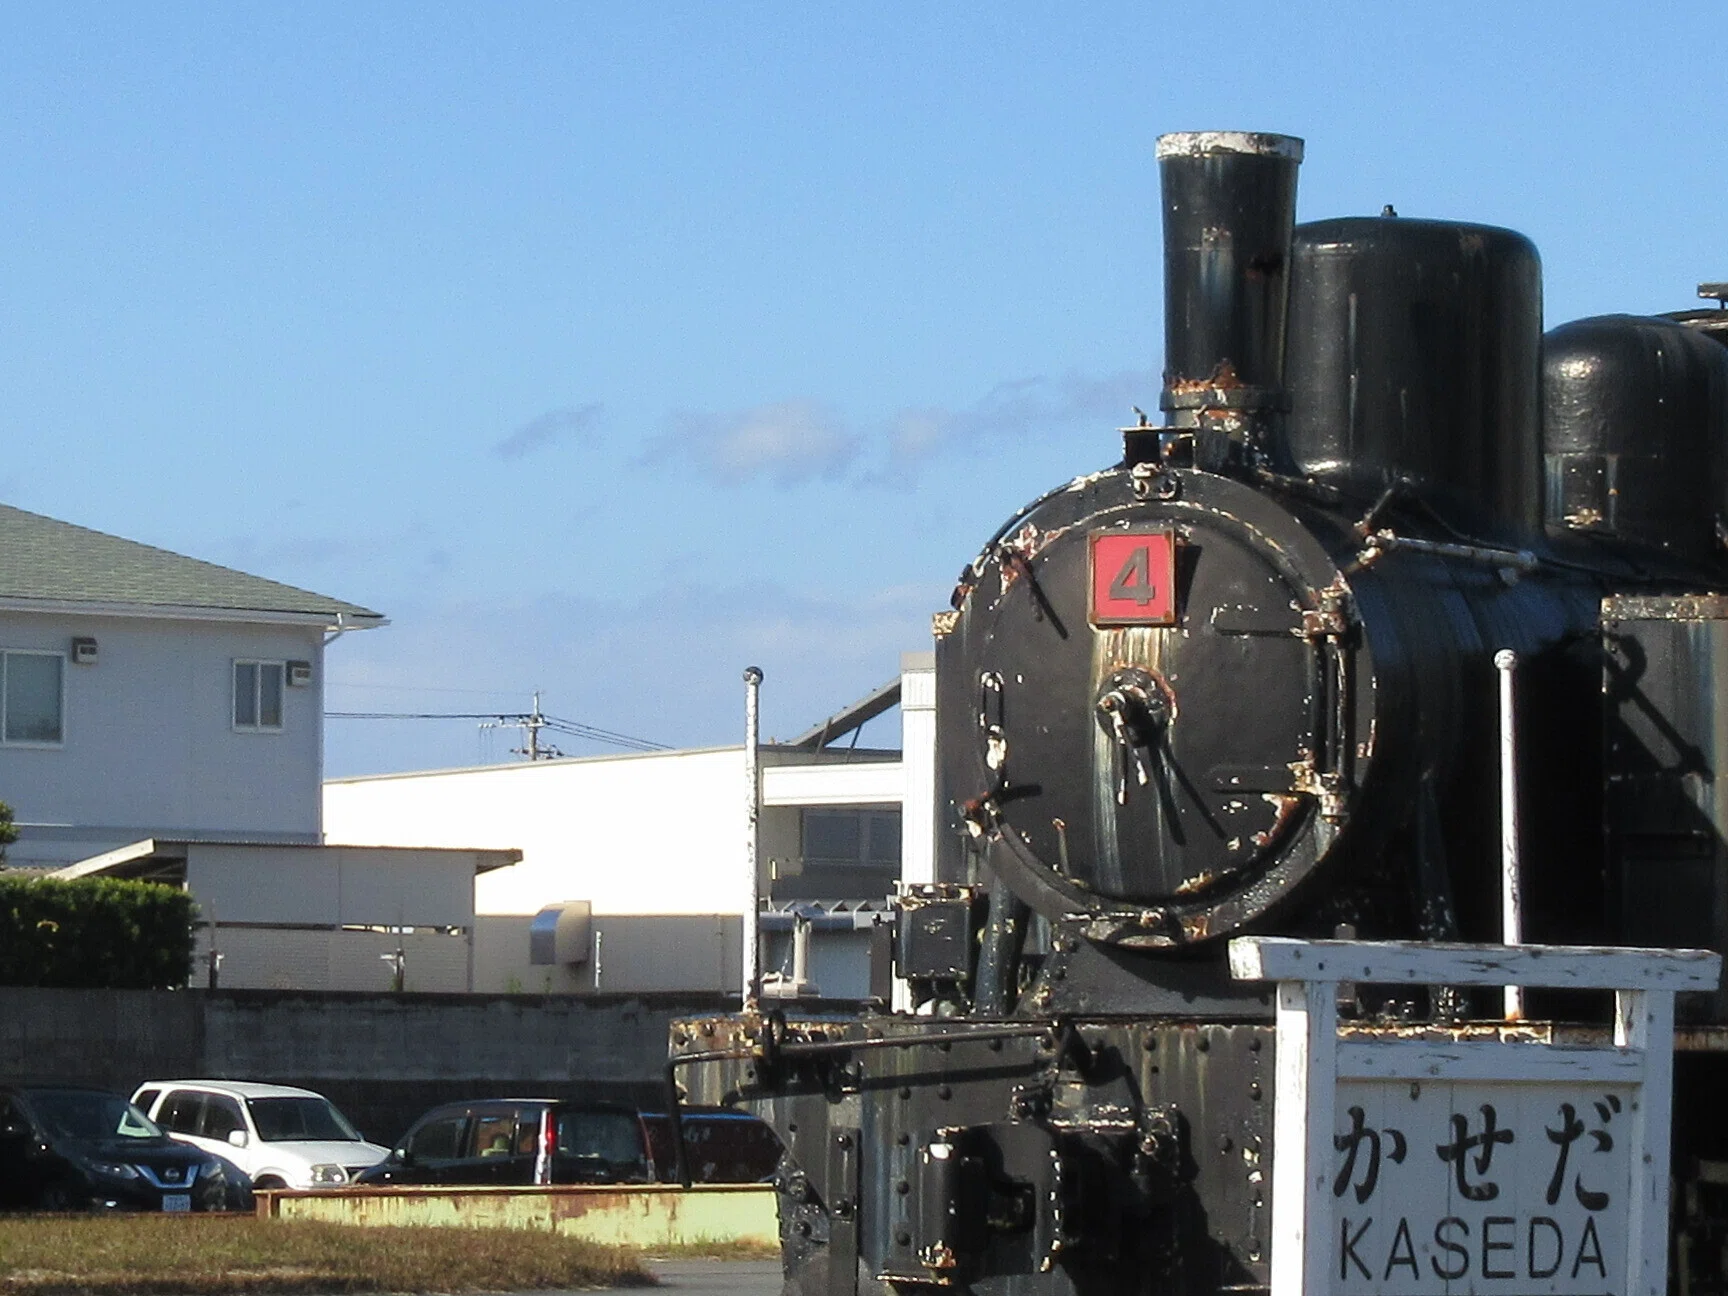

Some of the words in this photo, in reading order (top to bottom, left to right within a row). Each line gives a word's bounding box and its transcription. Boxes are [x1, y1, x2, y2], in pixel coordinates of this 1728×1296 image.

[1109, 547, 1155, 605] 4
[1333, 1095, 1622, 1211] かせだ
[1340, 1217, 1607, 1281] KASEDA
